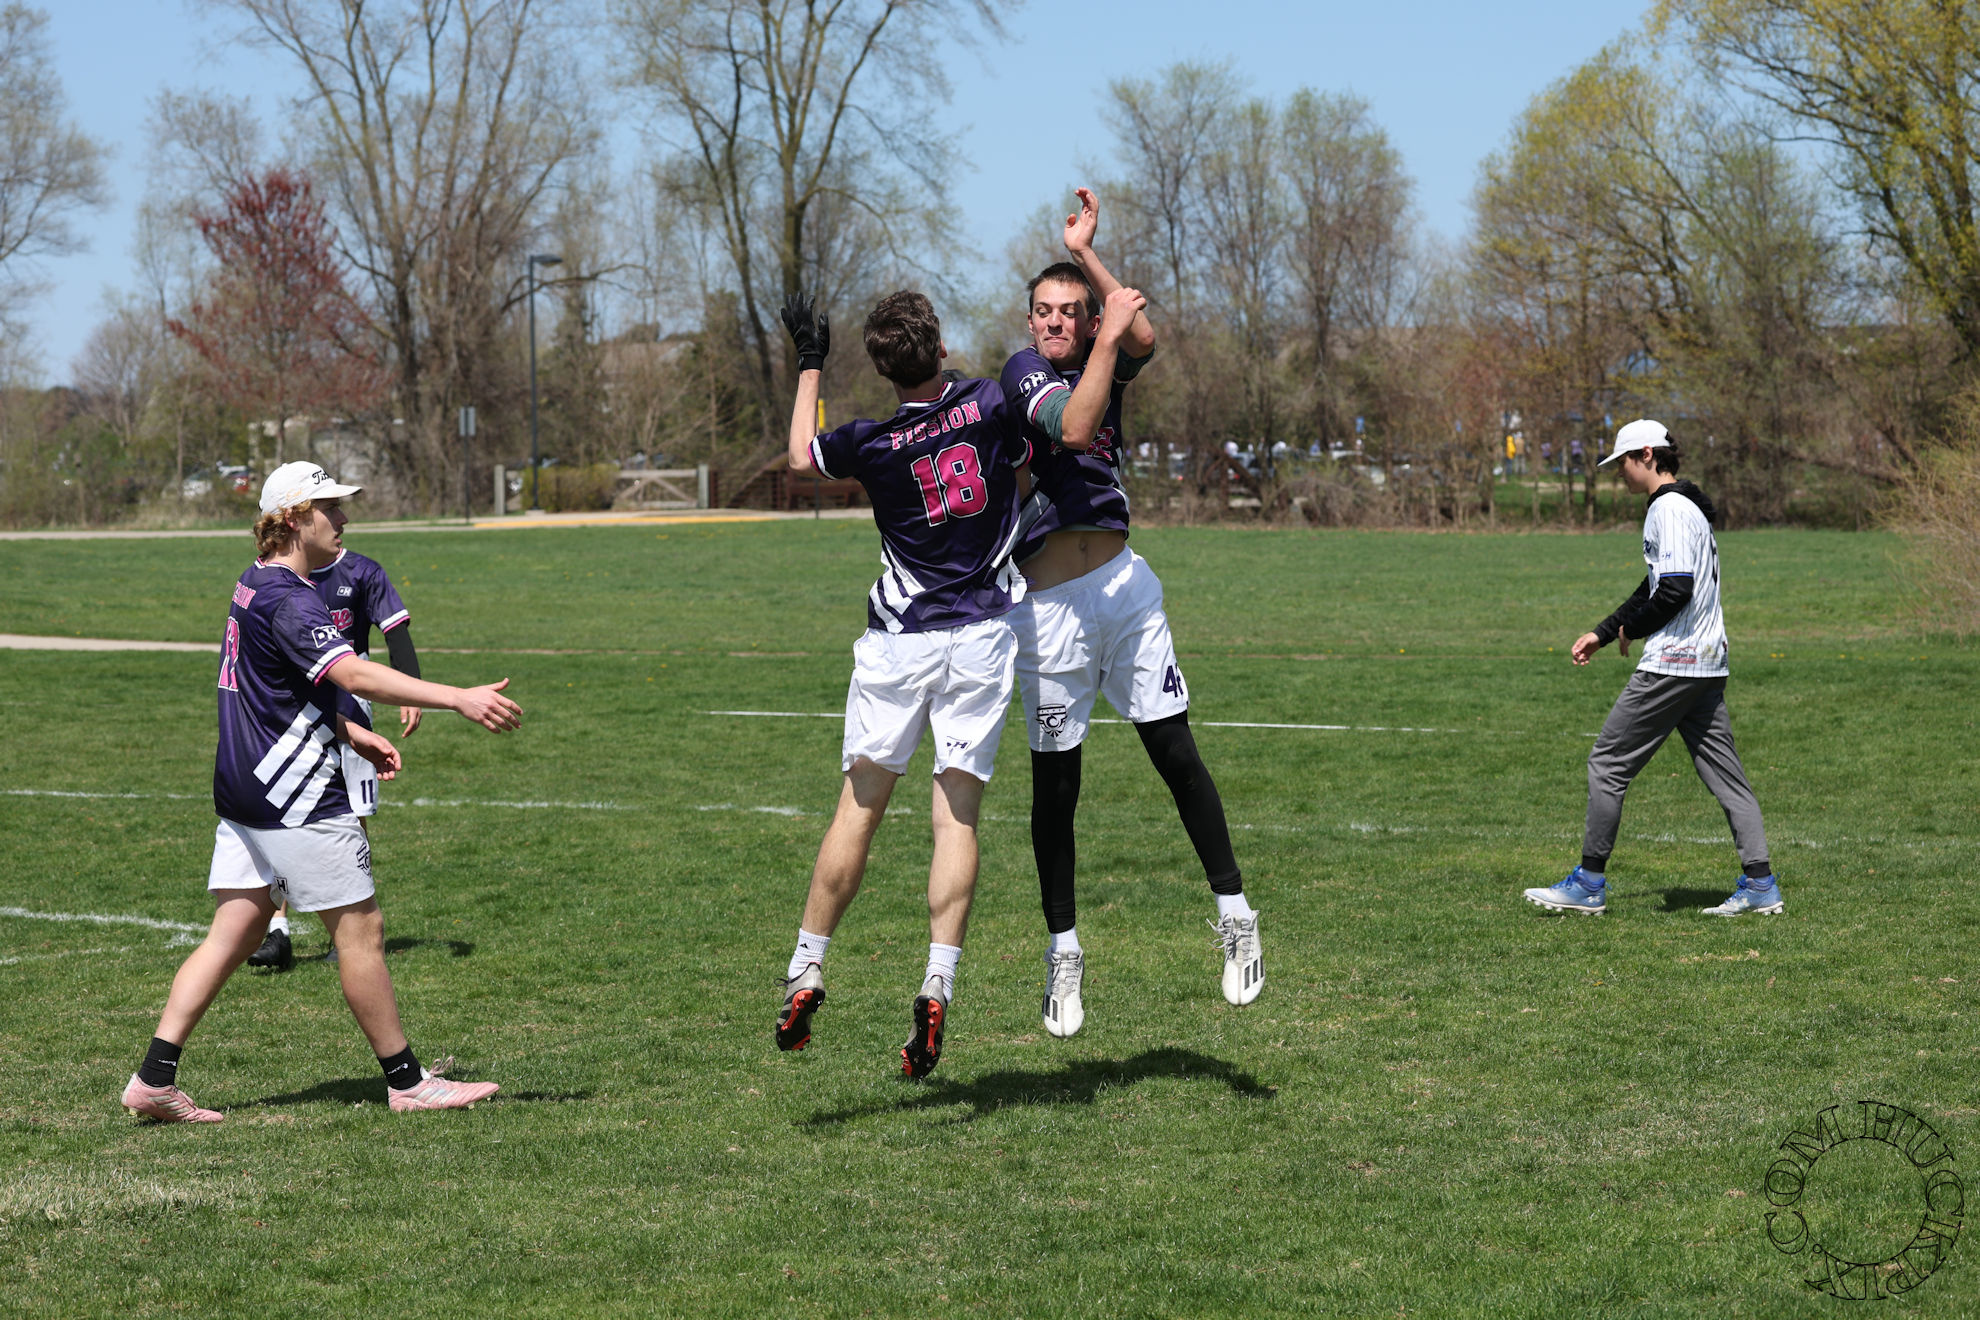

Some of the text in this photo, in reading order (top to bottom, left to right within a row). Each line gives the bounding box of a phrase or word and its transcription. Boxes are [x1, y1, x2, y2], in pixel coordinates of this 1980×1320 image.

[890, 401, 982, 450] FISSION
[910, 441, 989, 527] 18
[360, 779, 374, 804] 11
